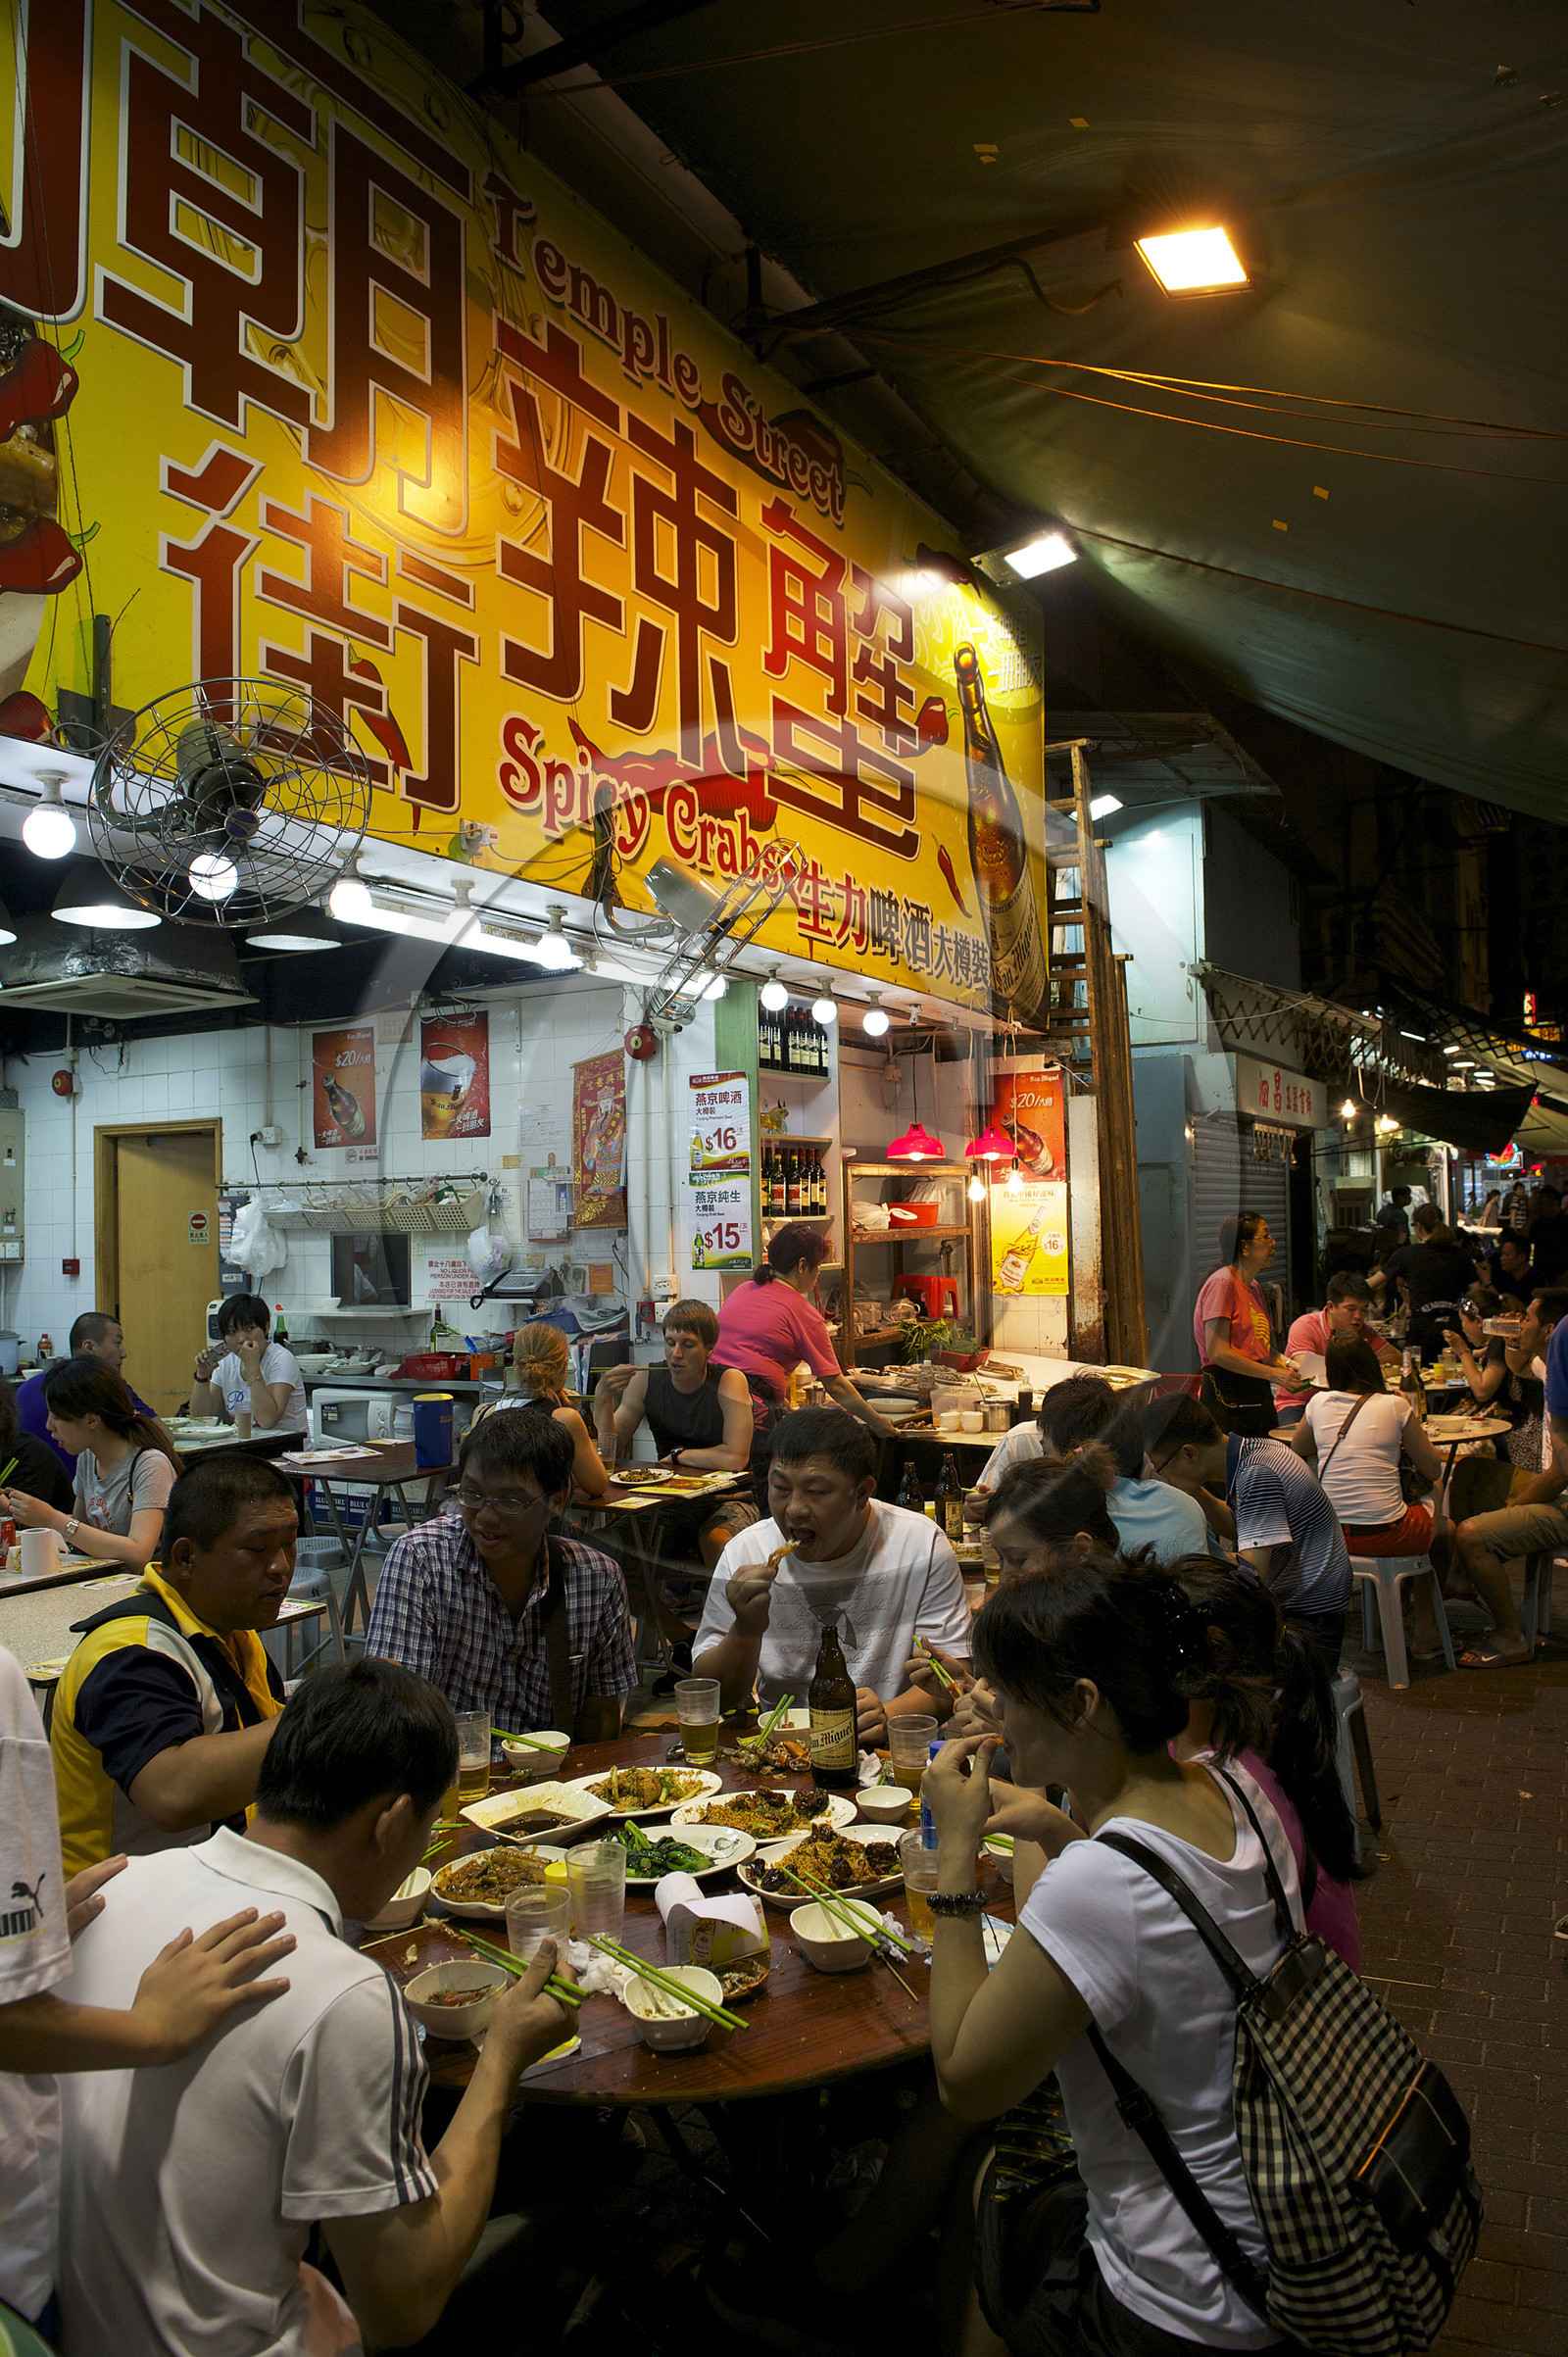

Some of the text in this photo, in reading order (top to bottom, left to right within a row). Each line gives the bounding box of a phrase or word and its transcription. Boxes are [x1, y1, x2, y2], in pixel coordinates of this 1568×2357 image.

[484, 169, 844, 525] Temple Street
[664, 780, 788, 893] Crabs
[696, 1091, 742, 1106] 燕京啤酒
[706, 1127, 737, 1152] $16
[695, 1190, 741, 1203] 燕京純生
[705, 1222, 741, 1251] $15
[1044, 1240, 1059, 1250] $16
[316, 1496, 328, 1504] BLU
[820, 1720, 853, 1747] Miguel
